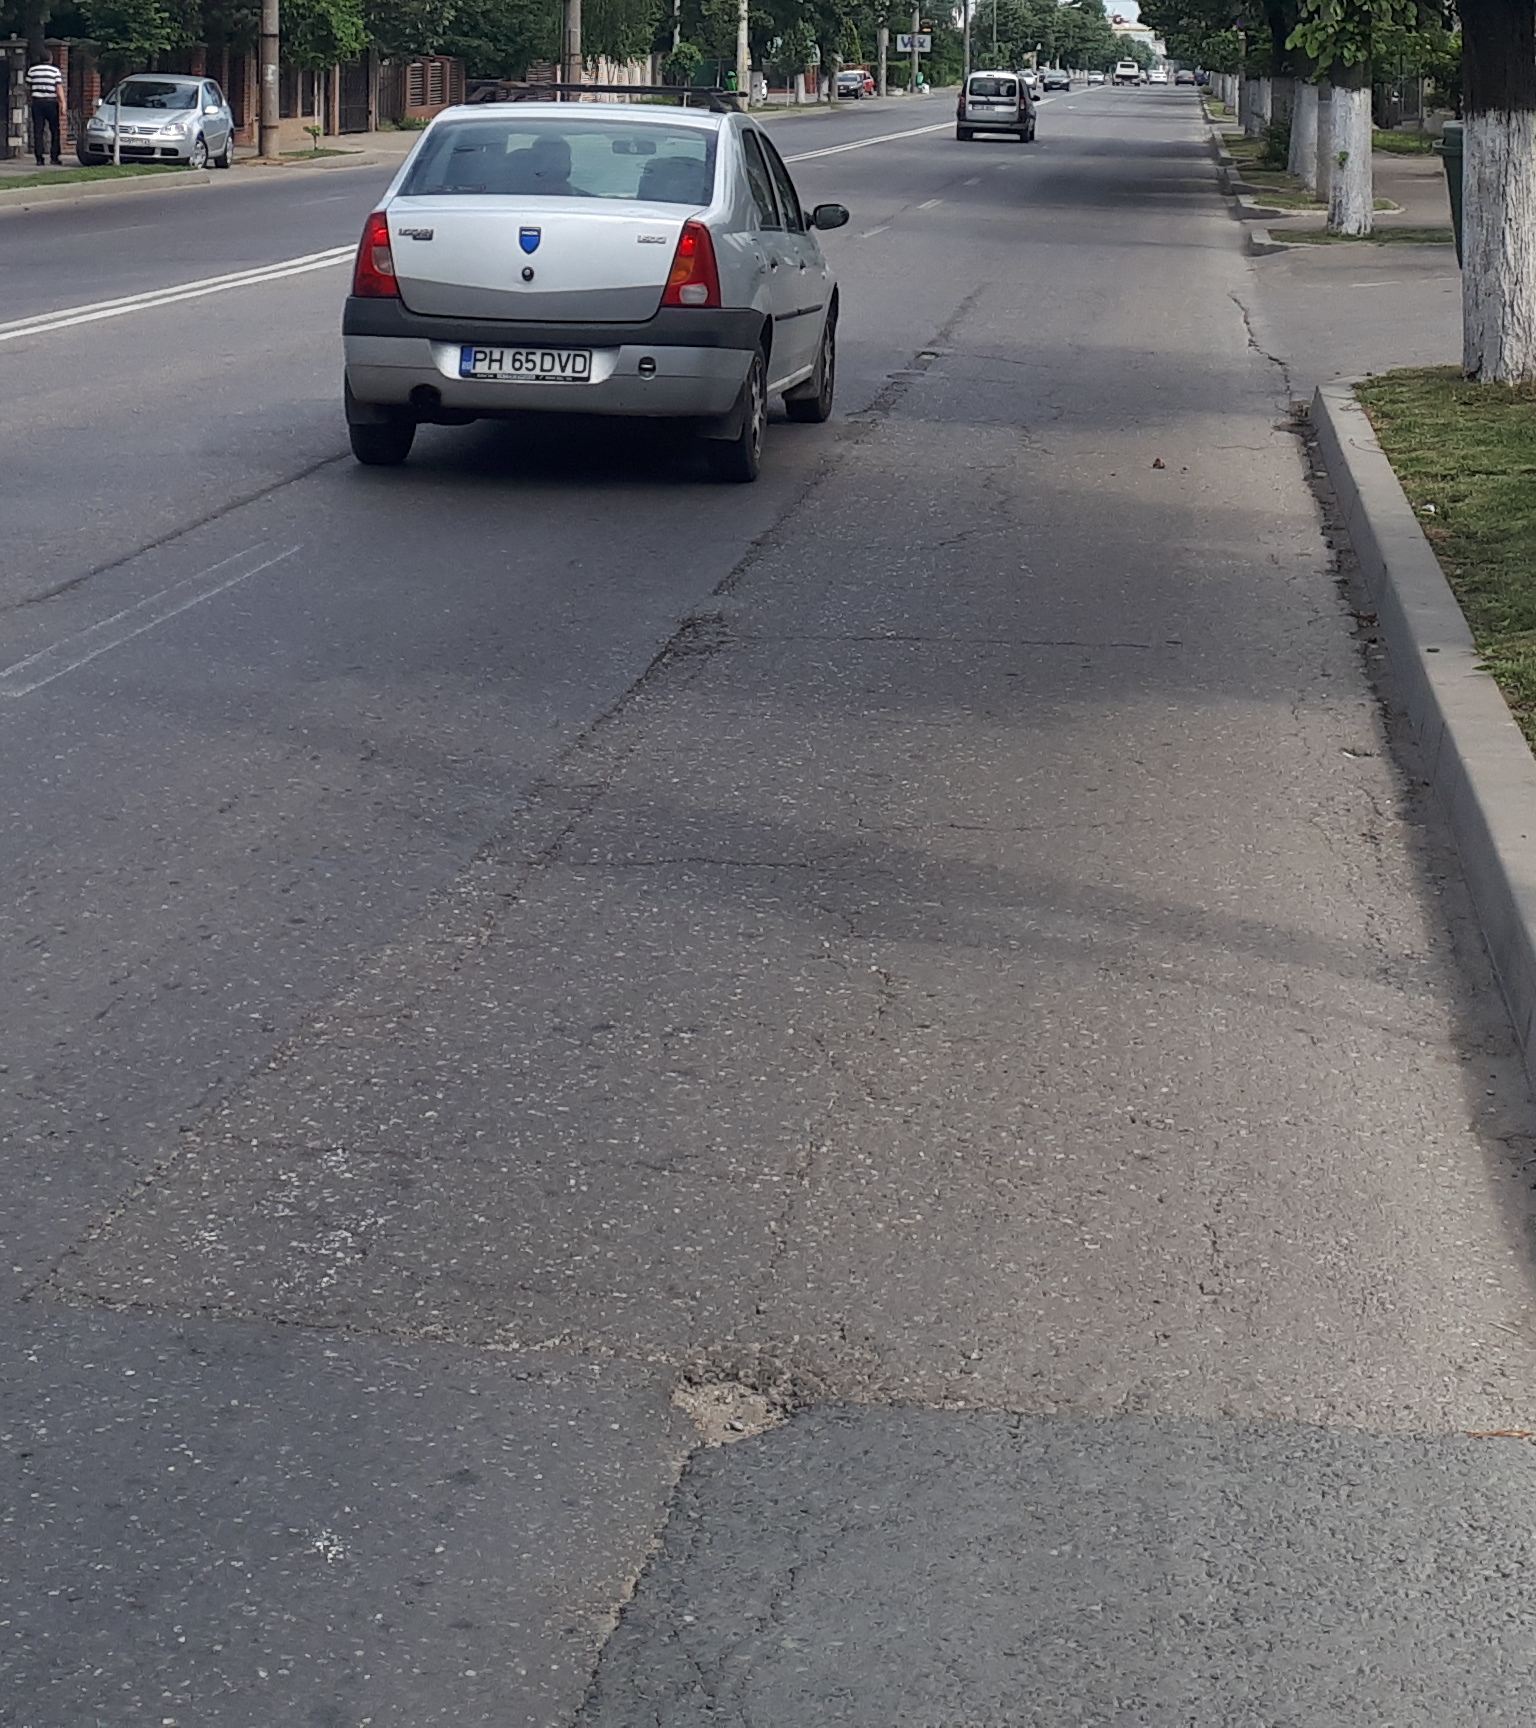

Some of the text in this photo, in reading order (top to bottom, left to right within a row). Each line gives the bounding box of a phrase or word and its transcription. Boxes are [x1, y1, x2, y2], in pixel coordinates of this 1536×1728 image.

[472, 350, 504, 371] PH
[511, 351, 537, 372] 65
[540, 352, 587, 374] DVD
